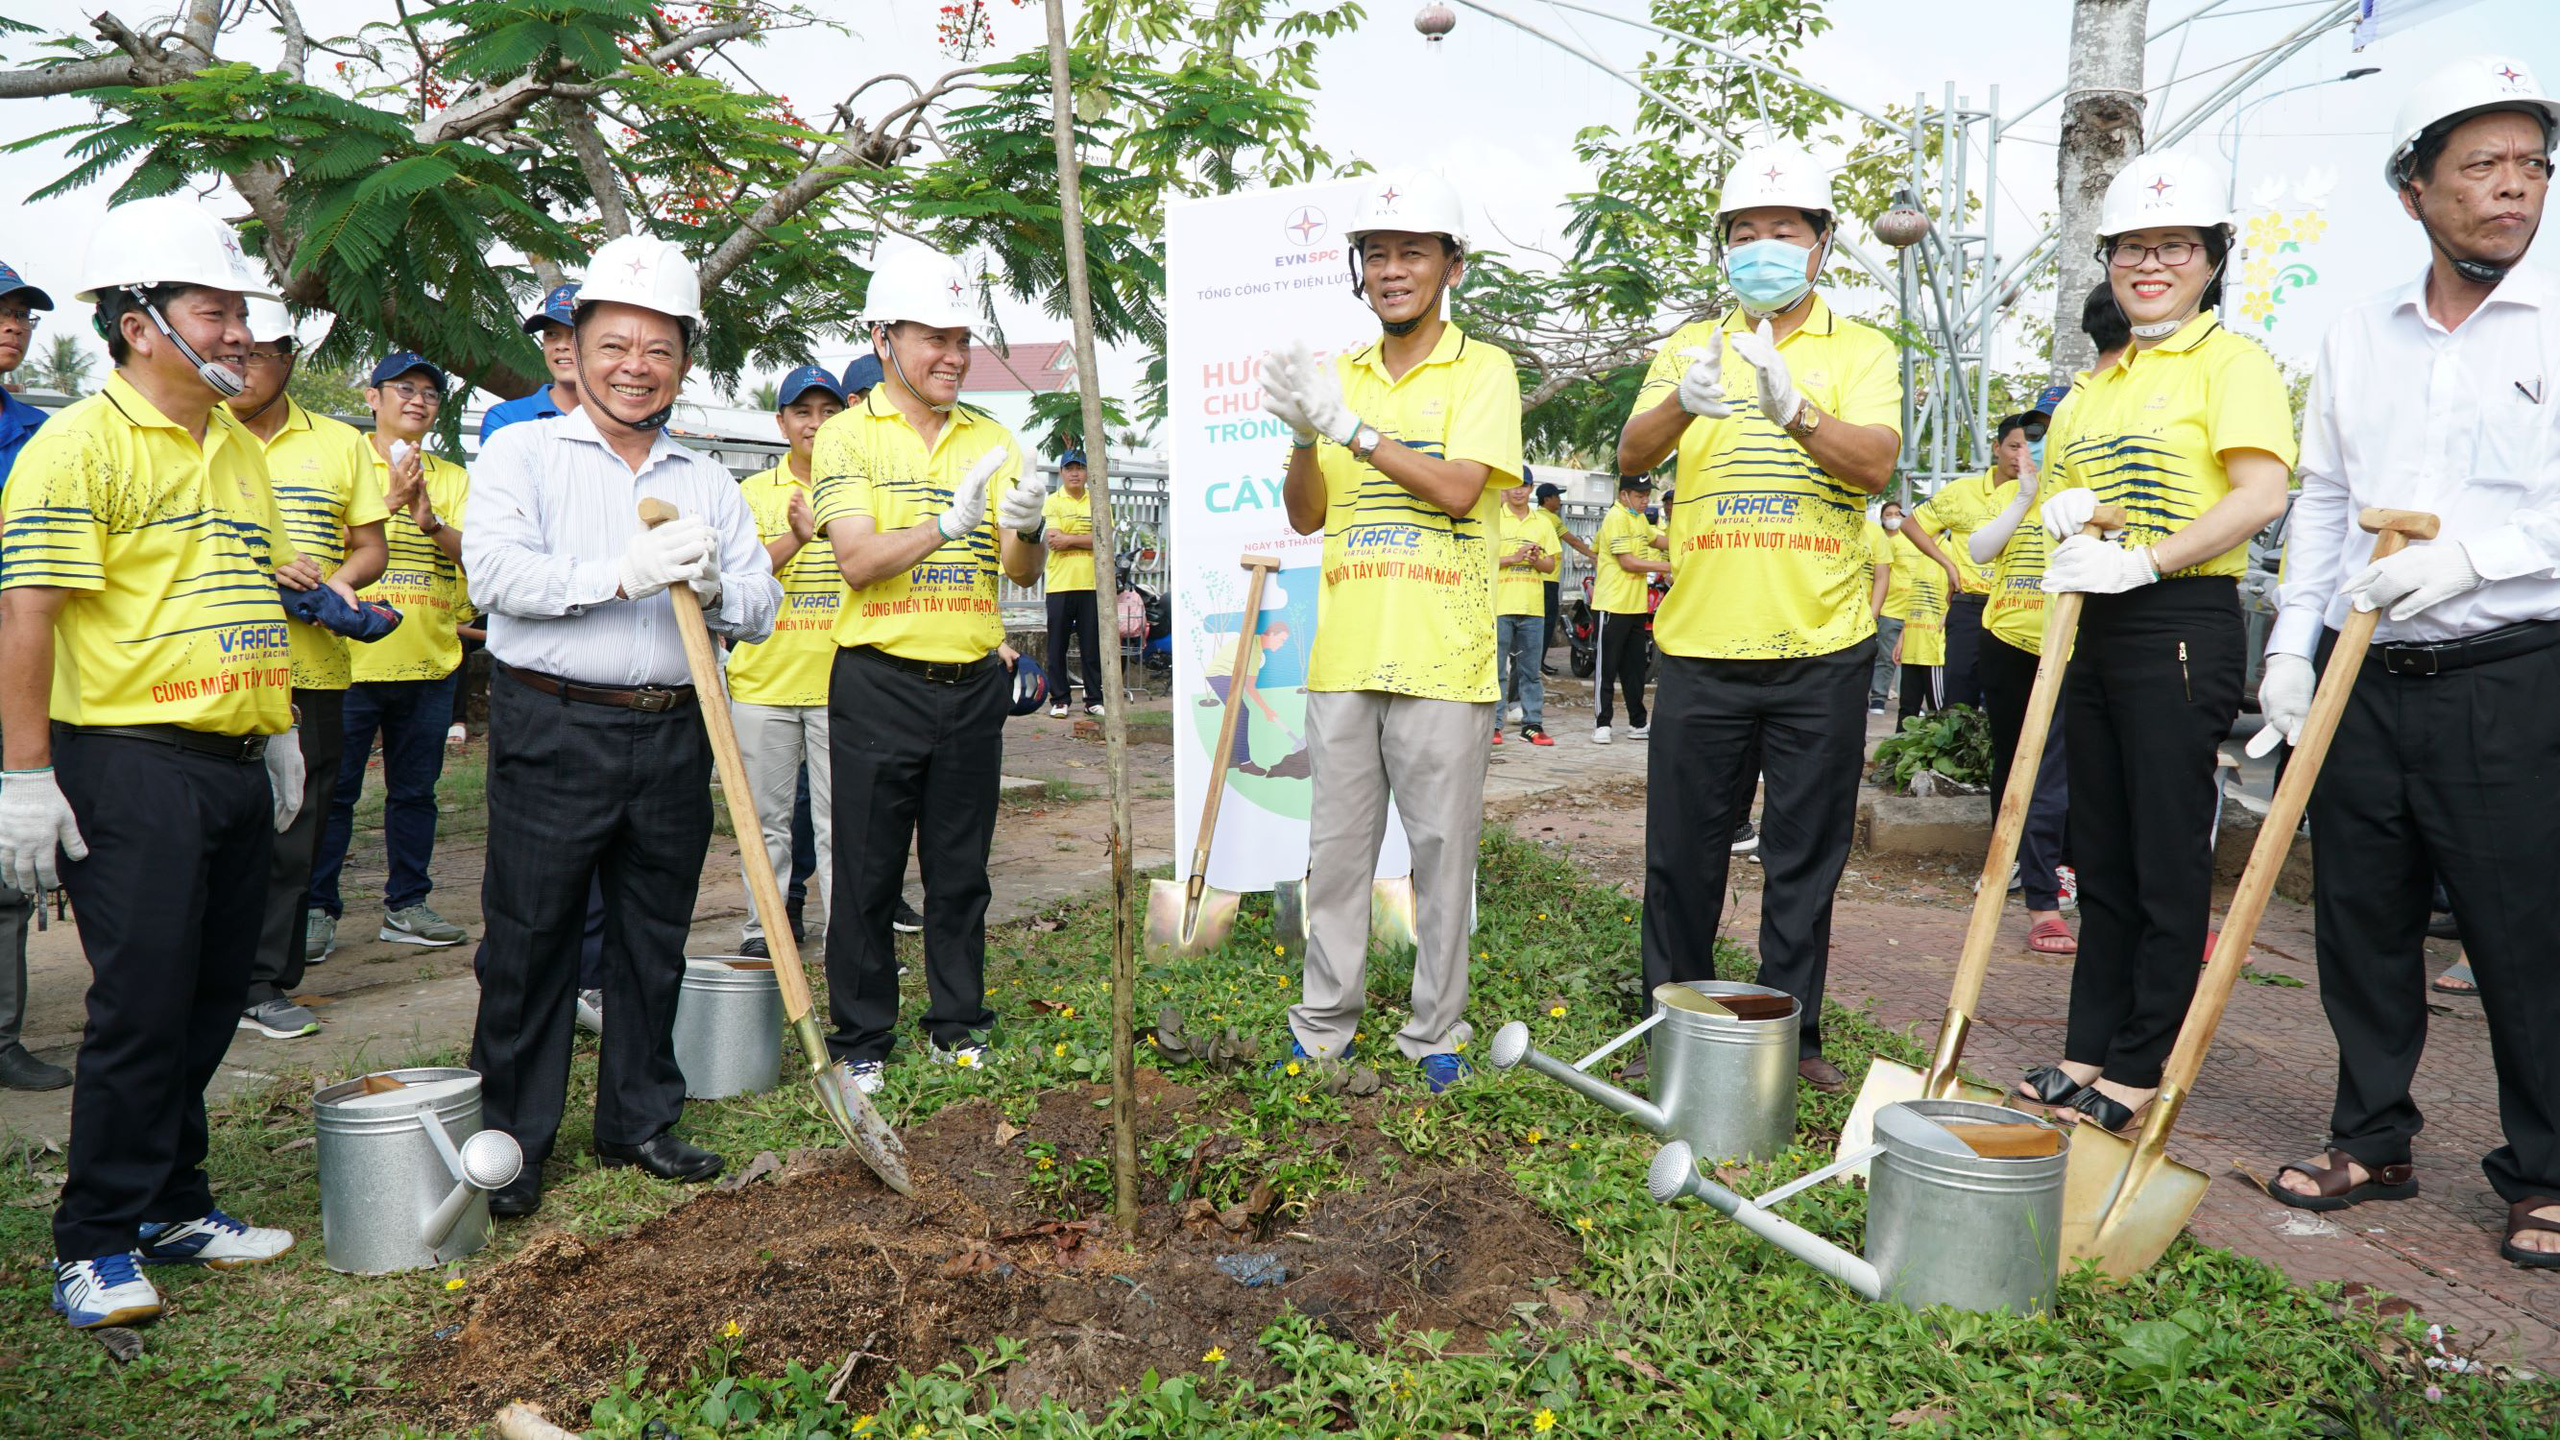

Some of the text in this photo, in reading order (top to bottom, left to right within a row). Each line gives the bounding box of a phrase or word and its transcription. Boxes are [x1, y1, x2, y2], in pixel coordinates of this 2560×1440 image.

[1275, 249, 1339, 267] EVNSPC
[1274, 280, 1289, 292] TY
[1205, 475, 1286, 513] CÂY
[1717, 497, 1798, 515] V-RACE
[1757, 516, 1793, 524] RACING
[1275, 540, 1285, 549] 18
[1347, 530, 1421, 548] V-RACE
[1726, 530, 1750, 549] TÂY
[1754, 532, 1786, 551] VƯỢT
[1344, 547, 1415, 557] VIRTUAL RACING
[912, 568, 977, 584] V-RACE
[1352, 560, 1373, 579] TÂY
[380, 573, 431, 586] V-RACE
[2006, 577, 2042, 590] V-RAC
[862, 600, 890, 617] CÙNG
[892, 594, 920, 615] MIỀN
[922, 595, 944, 613] TÂY
[946, 597, 971, 614] VƯỢT
[799, 617, 815, 631] TÂY
[218, 628, 289, 653] V-RACE
[219, 653, 259, 664] VIRTUAL
[152, 681, 198, 704] CÙNG
[201, 669, 239, 697] MIỀN
[242, 667, 262, 690] TÂY
